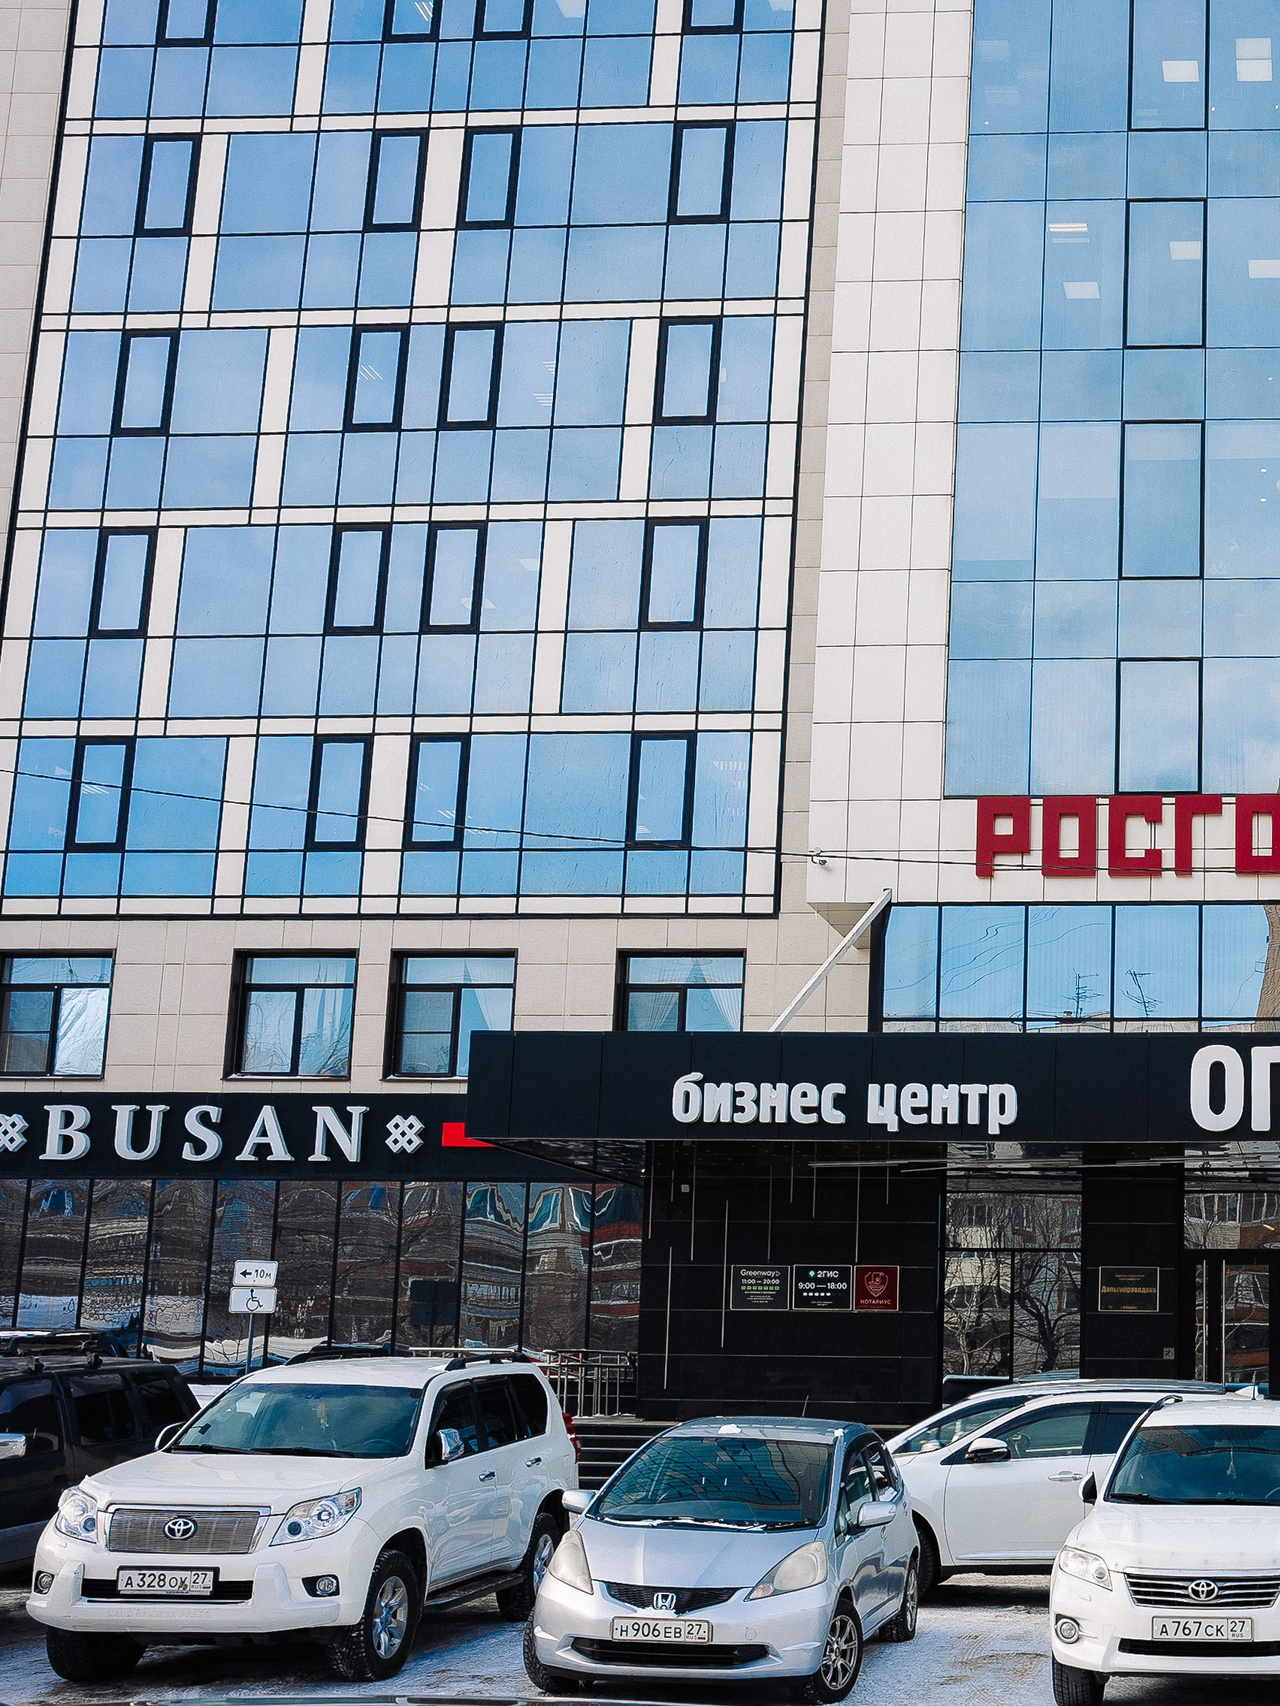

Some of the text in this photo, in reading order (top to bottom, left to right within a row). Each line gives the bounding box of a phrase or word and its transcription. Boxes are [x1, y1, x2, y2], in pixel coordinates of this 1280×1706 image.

[672, 1072, 1018, 1134] бизнес центр
[38, 1105, 370, 1162] BUSAN
[740, 1269, 776, 1278] Greenway
[816, 1270, 839, 1278] 2ГИС
[827, 1282, 847, 1290] 18:00
[193, 1573, 208, 1584] 27
[620, 1622, 702, 1639] Н906ЕВ 27
[1160, 1621, 1245, 1637] А767СК 27
